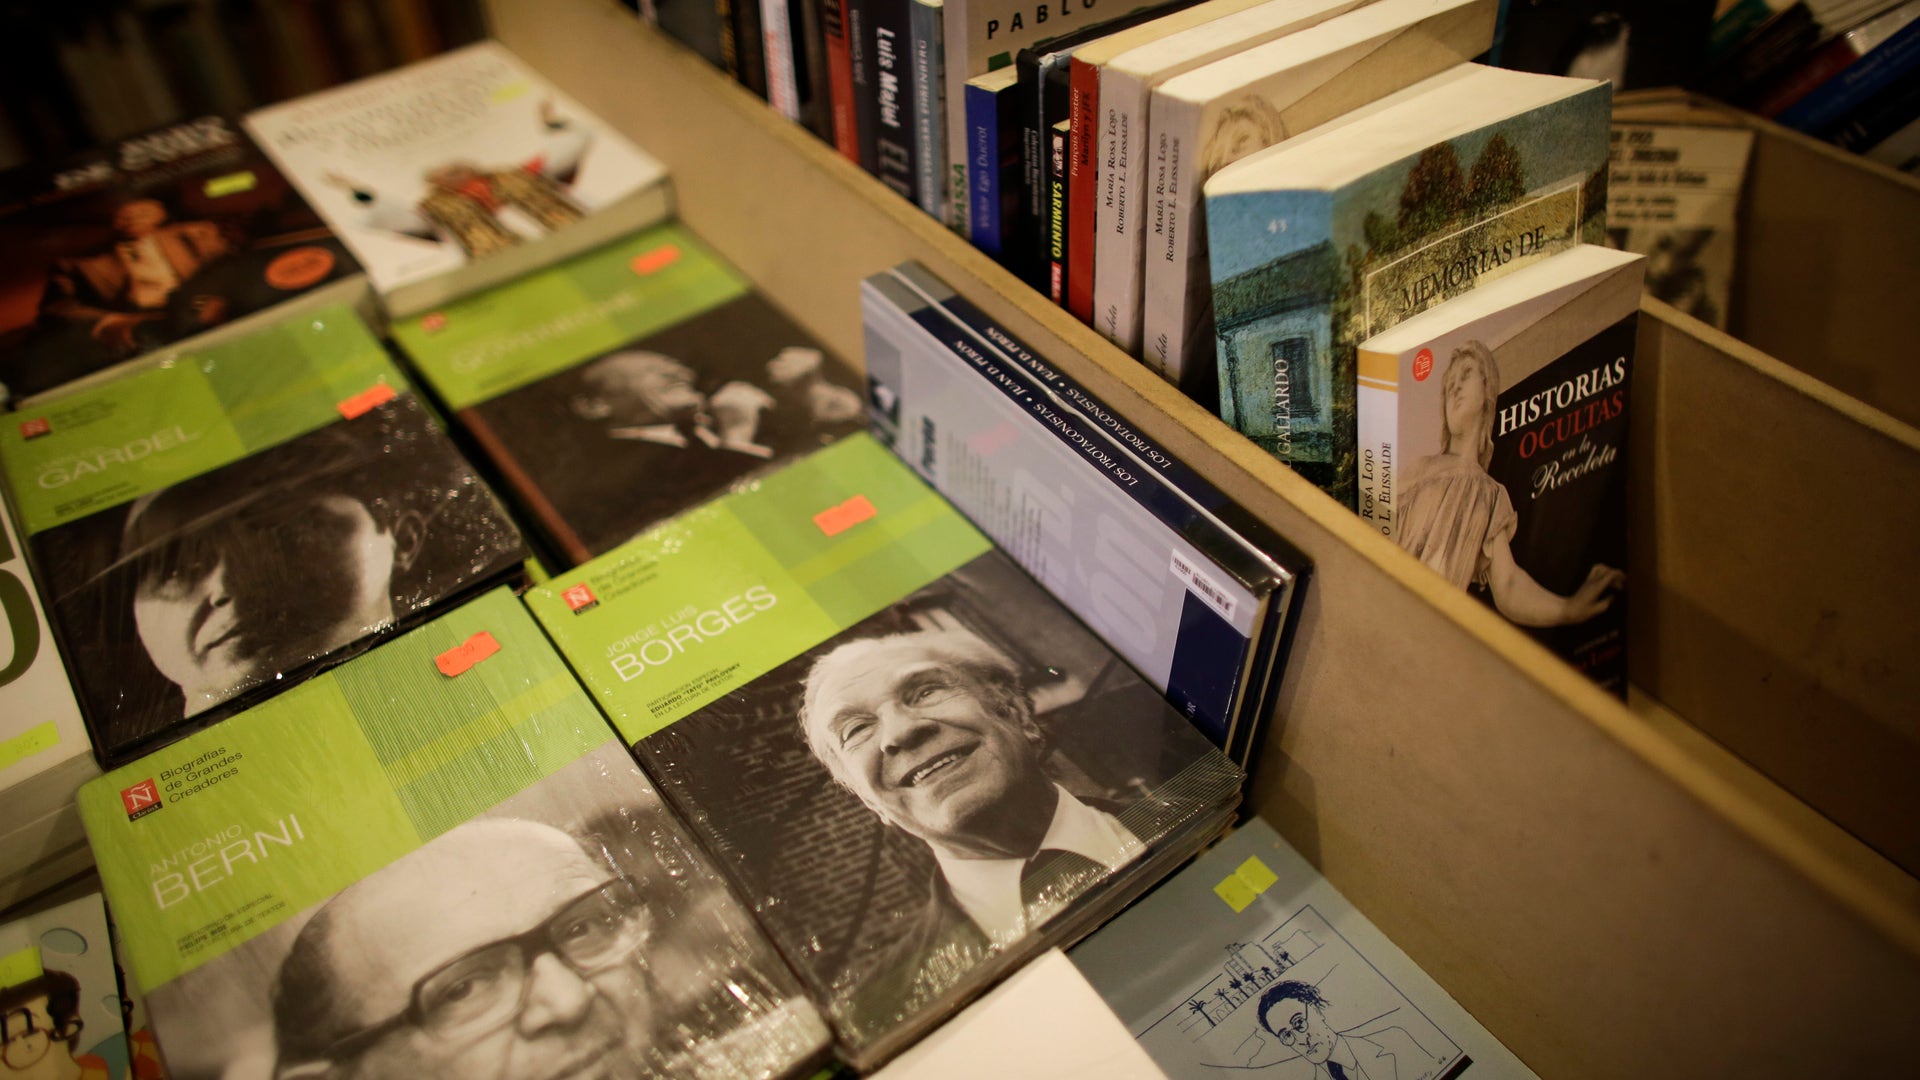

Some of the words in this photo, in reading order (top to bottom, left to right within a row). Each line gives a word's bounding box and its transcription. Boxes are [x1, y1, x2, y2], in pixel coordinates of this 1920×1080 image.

[987, 0, 1095, 39] PABLO
[876, 27, 897, 69] Luis
[877, 71, 900, 127] Majul
[917, 40, 931, 115] EHRENBERG
[1070, 88, 1080, 134] Forestier
[1080, 90, 1091, 112] JFK
[977, 126, 989, 167] Ducrot
[1070, 135, 1080, 177] François
[1079, 123, 1090, 167] Marilyn
[1051, 181, 1063, 258] SARMIENTO
[1400, 246, 1509, 313] MEMORIAS
[1510, 224, 1546, 263] DE
[986, 362, 1002, 377] D.
[1018, 346, 1035, 361] D.
[1031, 355, 1061, 382] JUAN
[999, 371, 1028, 398] JUAN
[1498, 355, 1626, 437] HISTORIAS
[1065, 386, 1151, 453] PROTAGONISTAS
[1273, 358, 1292, 455] GALLARDO
[1518, 390, 1624, 459] OCULTAS
[38, 424, 201, 490] GARDEL
[1033, 402, 1118, 470] PROTAGONISTAS
[1562, 447, 1578, 462] en
[1578, 434, 1591, 456] la
[1114, 466, 1139, 488] LOS
[1147, 449, 1173, 469] LOS
[1530, 442, 1618, 499] Recoleta
[1379, 509, 1391, 523] L.
[605, 633, 662, 660] JORGE
[660, 604, 699, 640] LUIS
[610, 583, 778, 683] BORGES
[649, 694, 684, 715] EDUARDO
[159, 745, 227, 783] Biografías
[164, 779, 184, 794] de
[185, 751, 244, 784] Grandes
[168, 765, 240, 804] Creadores
[127, 783, 154, 810] Ñ
[150, 824, 243, 875] ANTONIO
[151, 812, 305, 910] BERNI
